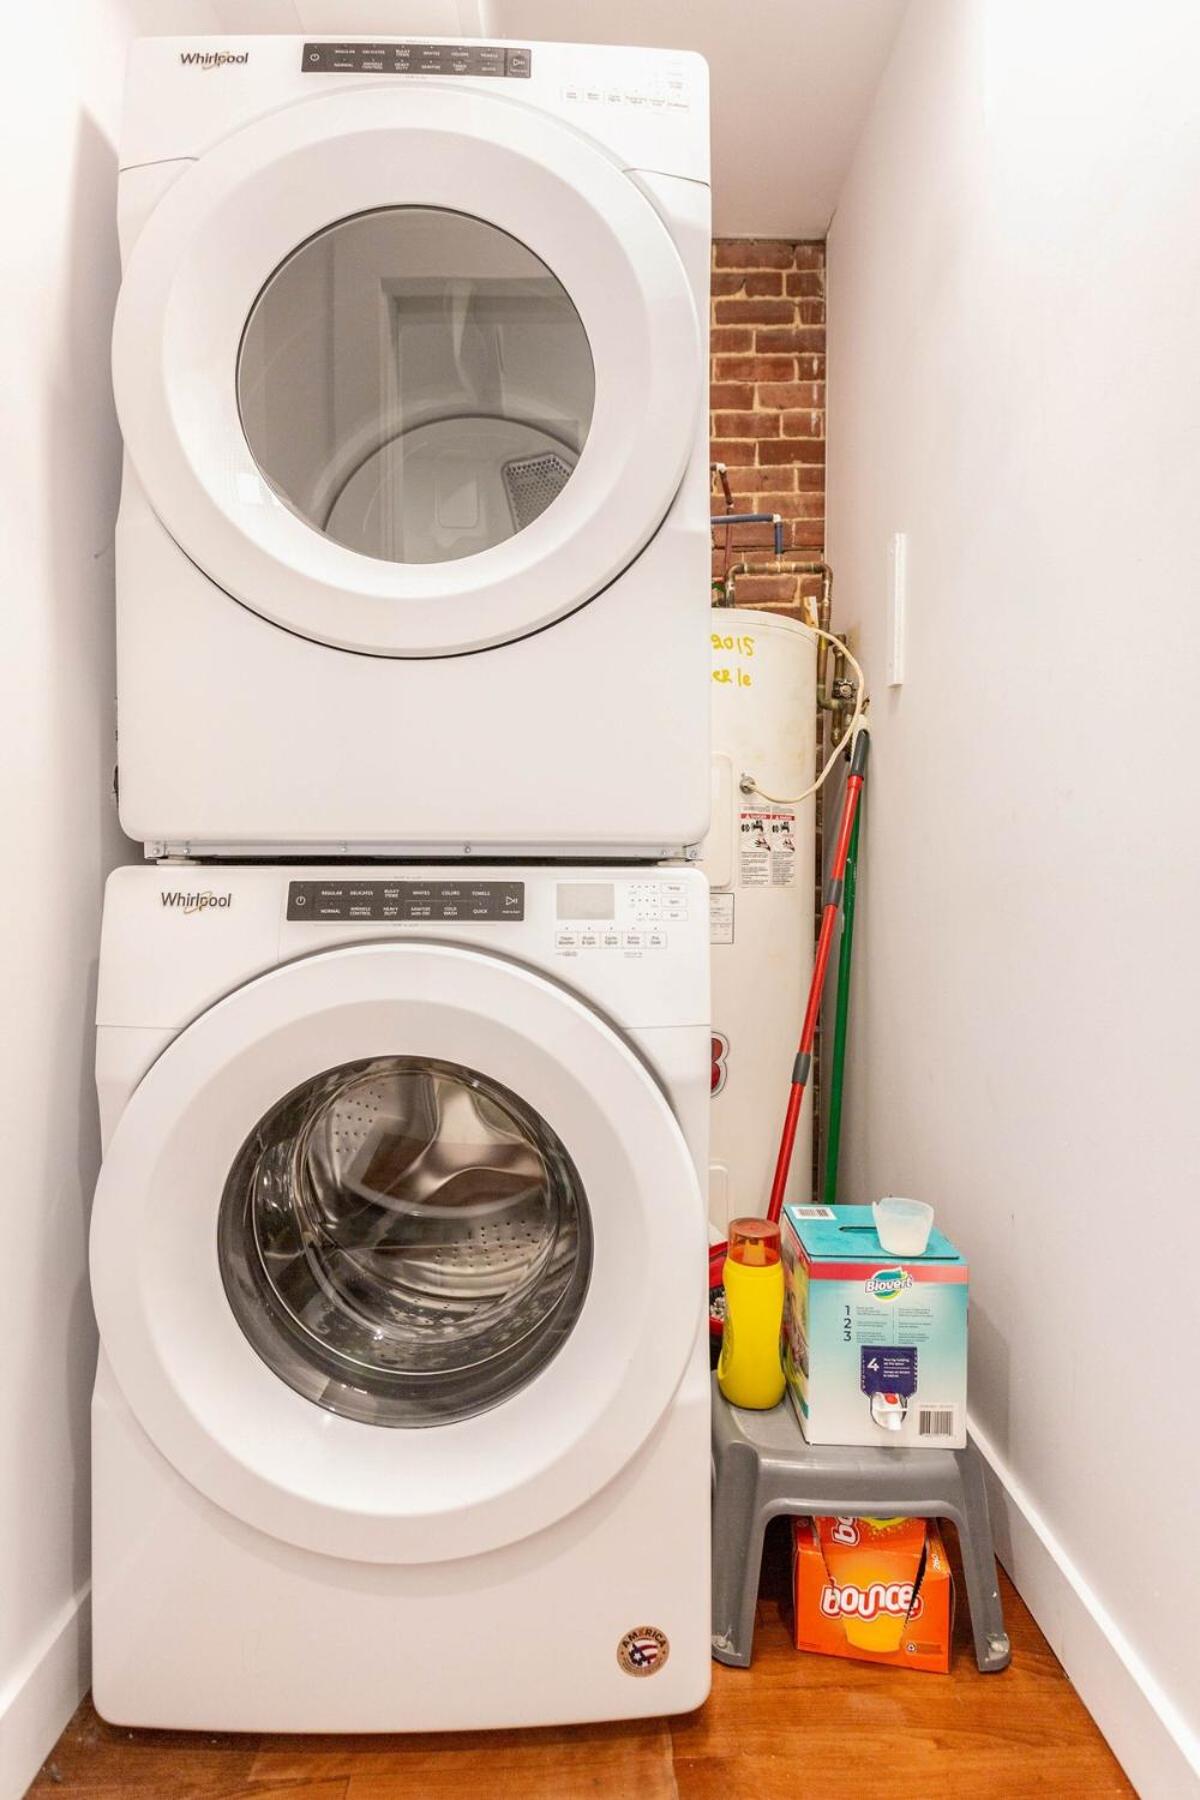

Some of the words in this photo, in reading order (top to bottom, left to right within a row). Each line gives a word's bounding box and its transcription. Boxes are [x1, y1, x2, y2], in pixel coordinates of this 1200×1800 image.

[180, 52, 249, 68] Whirlpool
[161, 892, 232, 911] Whirlpool
[864, 1274, 913, 1294] Biovert
[844, 1305, 851, 1316] 1
[843, 1318, 852, 1329] 2
[843, 1330, 852, 1342] 3
[866, 1357, 880, 1372] 4
[821, 1582, 920, 1619] bounce
